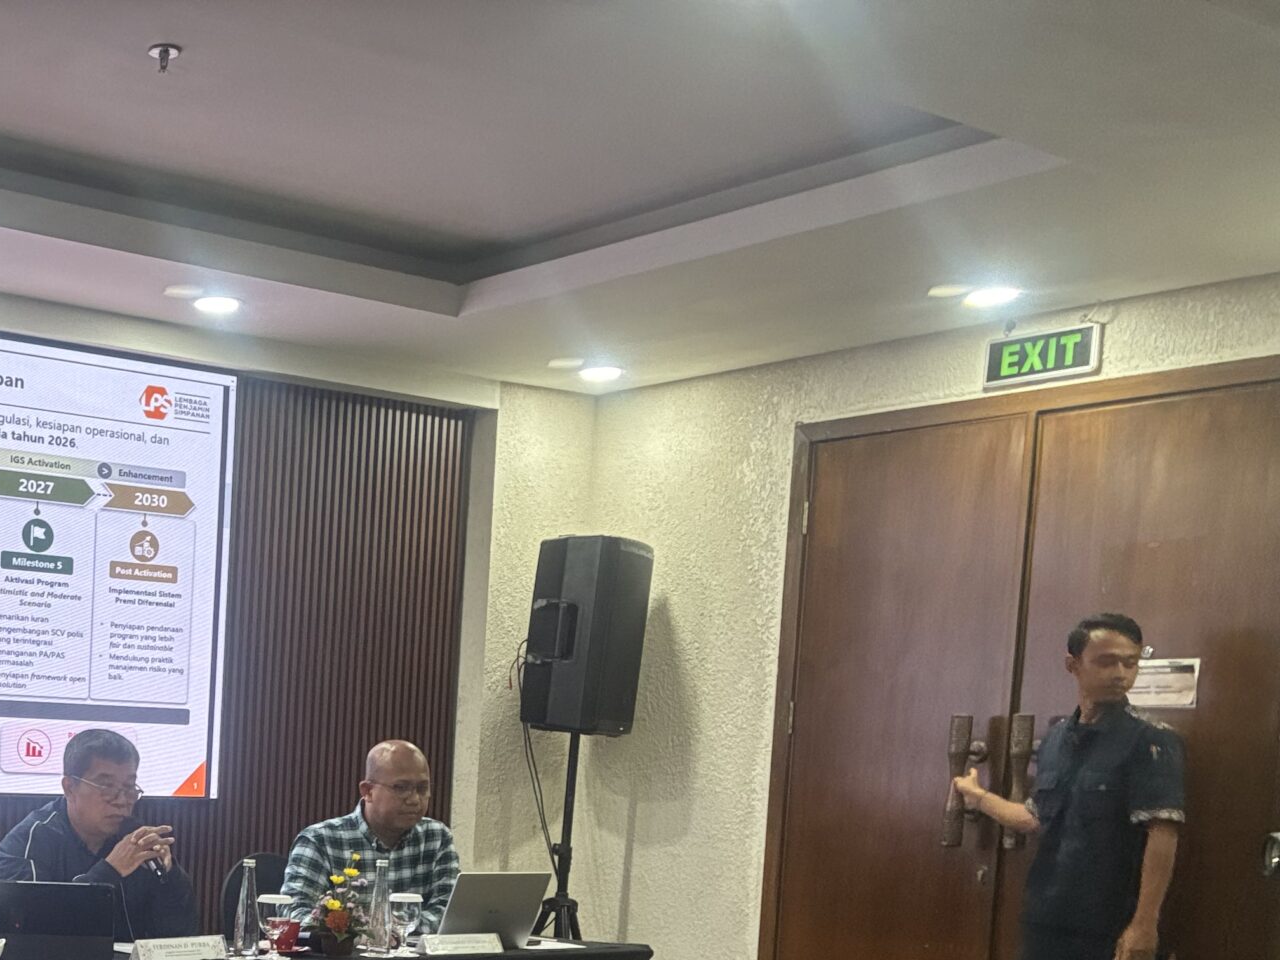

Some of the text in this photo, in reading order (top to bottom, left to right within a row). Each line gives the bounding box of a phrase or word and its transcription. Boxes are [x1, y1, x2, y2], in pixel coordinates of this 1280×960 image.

[1000, 334, 1082, 376] EXIT
[142, 393, 172, 413] LPS
[175, 397, 208, 406] LEMBAGA
[34, 417, 82, 434] kesiapan
[84, 426, 147, 443] operasional,
[148, 433, 169, 445] dan
[10, 430, 45, 444] tahun
[47, 434, 78, 448] 2026.
[9, 455, 71, 470] IGS Activation
[118, 468, 172, 483] Enhancement
[18, 478, 54, 494] 2027
[134, 492, 167, 507] 2030
[11, 556, 62, 569] Milestone 5
[115, 566, 172, 579] Post Activation
